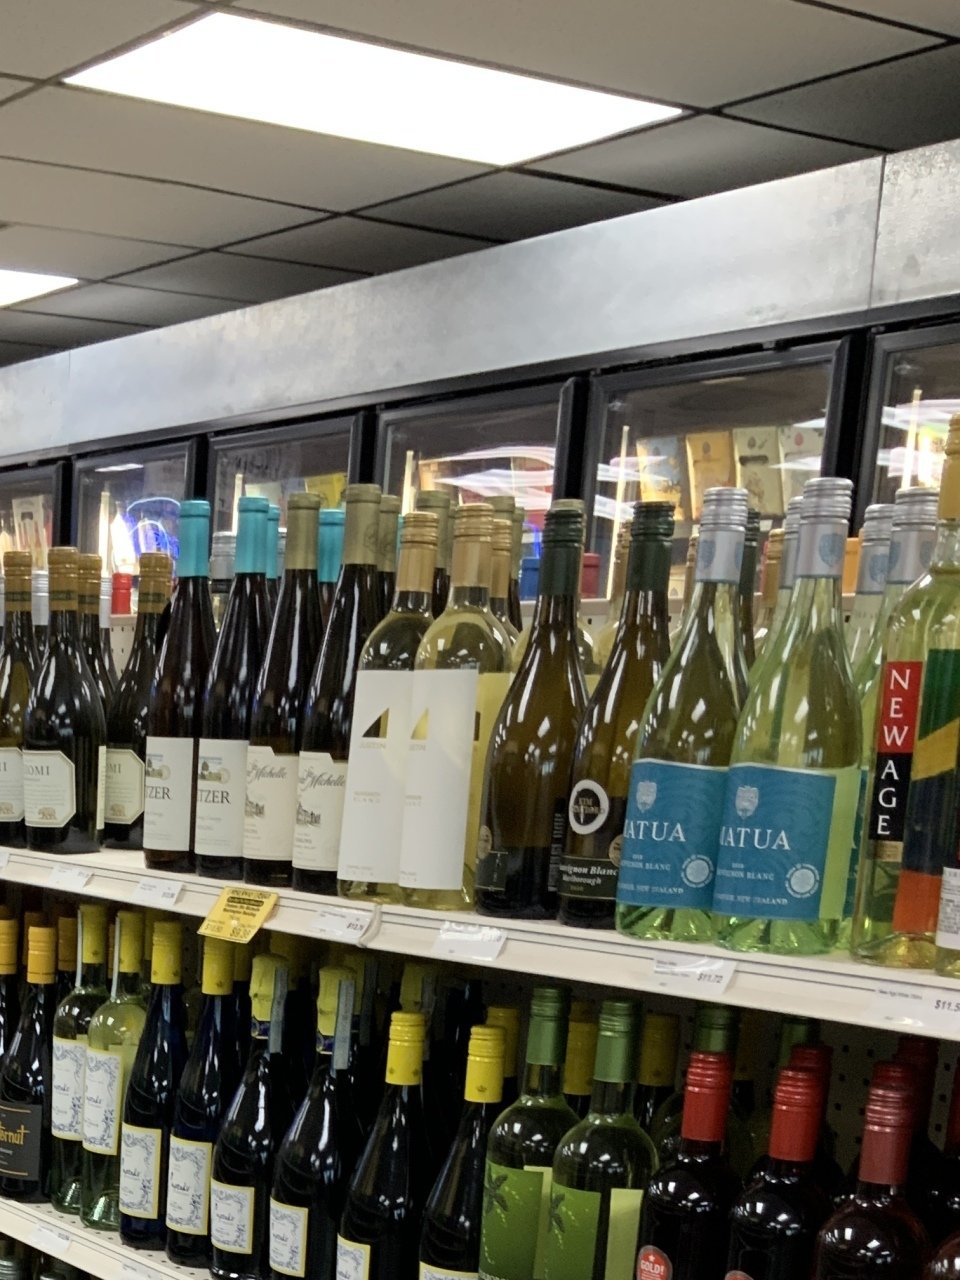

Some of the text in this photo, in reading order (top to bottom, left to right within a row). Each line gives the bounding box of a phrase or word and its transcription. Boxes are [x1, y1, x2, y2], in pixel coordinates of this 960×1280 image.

[877, 668, 911, 835] NEW AGE
[640, 1259, 665, 1275] GOLD!
